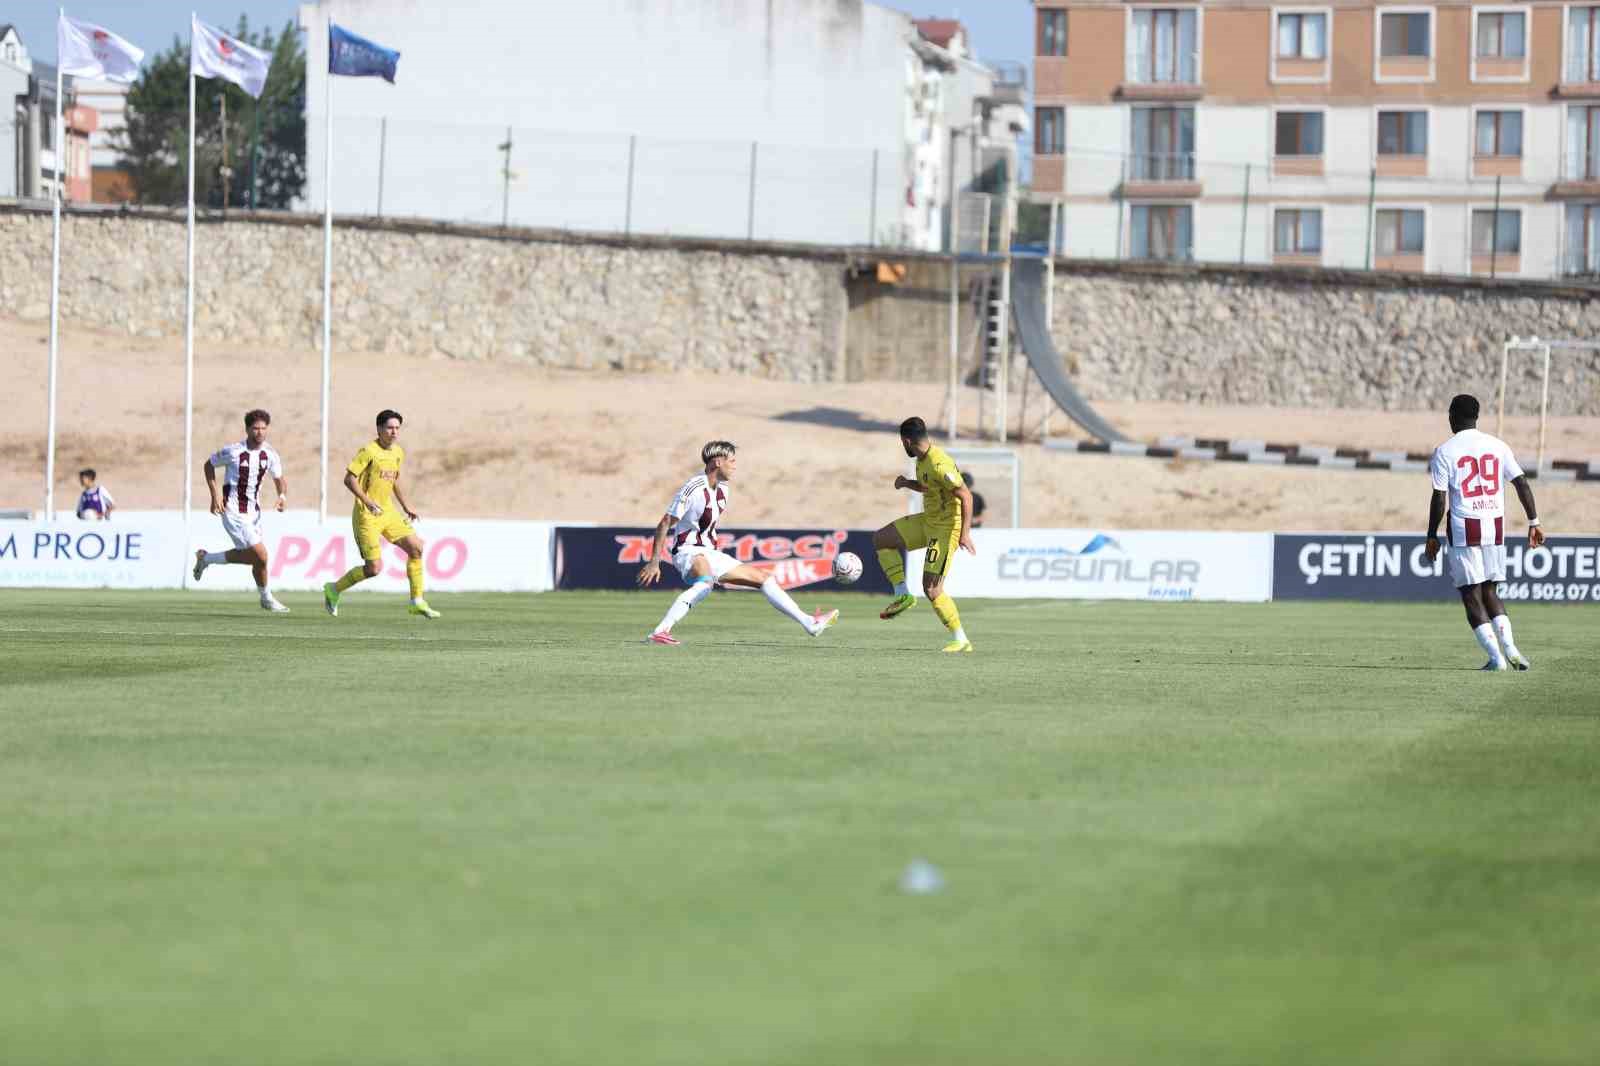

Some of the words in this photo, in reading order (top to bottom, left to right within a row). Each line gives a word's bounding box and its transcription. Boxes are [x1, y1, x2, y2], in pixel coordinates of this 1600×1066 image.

[1457, 453, 1500, 498] 29
[33, 532, 142, 560] PROJE
[271, 535, 469, 580] PASO
[1299, 536, 1401, 584] ÇETİN
[1502, 545, 1600, 577] HOTE
[1497, 582, 1530, 600] 266
[1531, 582, 1565, 600] 502
[1566, 582, 1590, 600] 07
